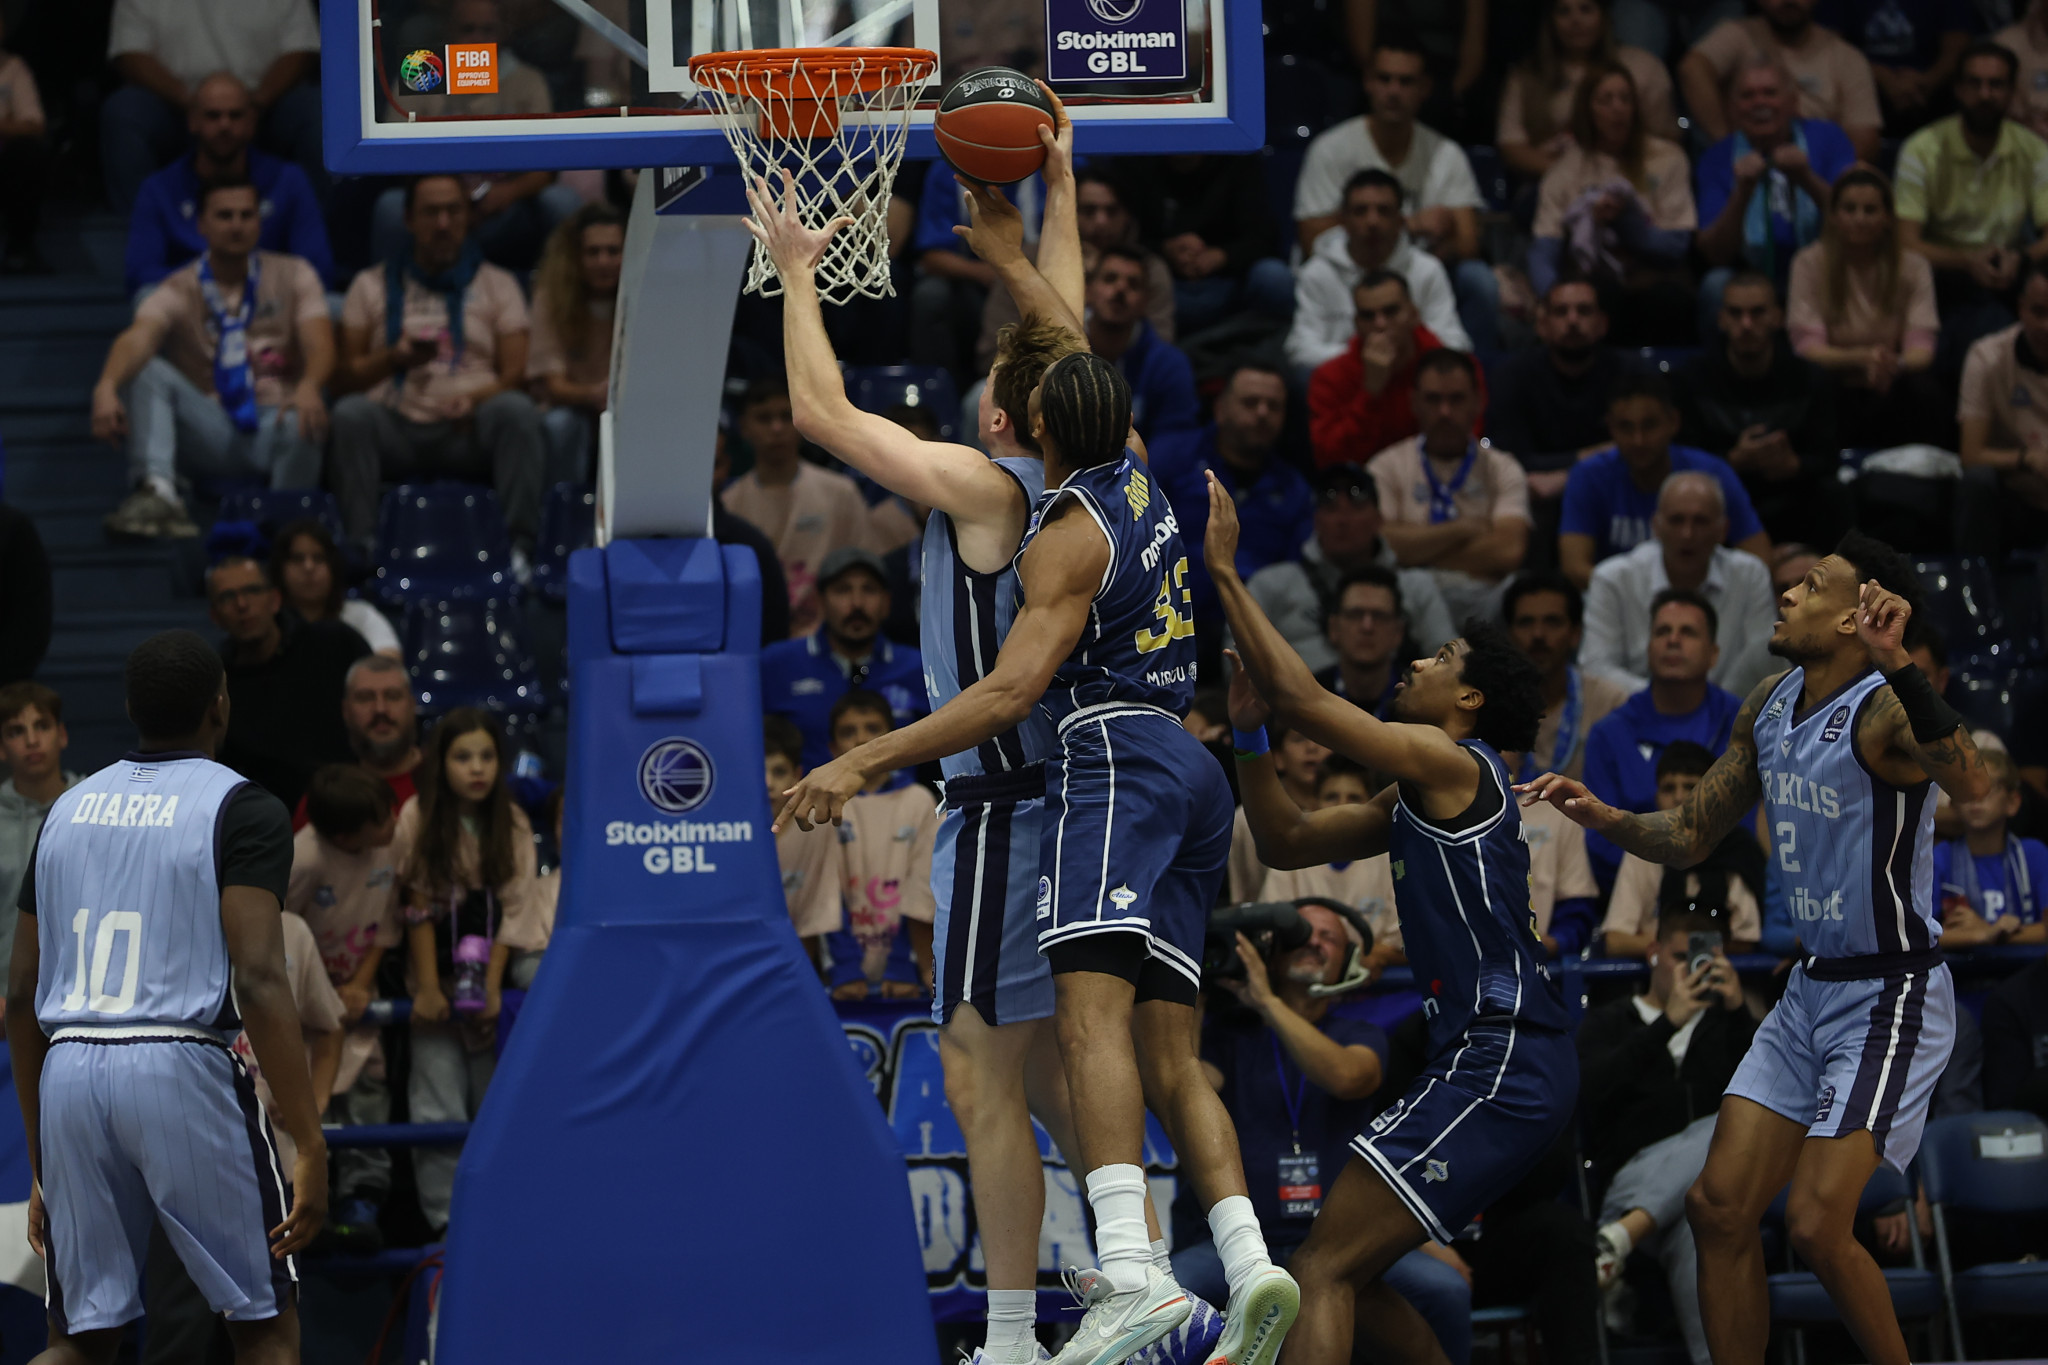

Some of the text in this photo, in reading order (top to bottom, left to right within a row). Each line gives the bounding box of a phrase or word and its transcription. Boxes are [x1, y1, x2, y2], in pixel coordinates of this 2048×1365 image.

[1057, 31, 1176, 50] Stoiximan
[456, 50, 490, 67] FIBA
[1087, 51, 1147, 74] GBL
[456, 79, 491, 87] EQUIPMENT
[1761, 769, 1841, 818] RKLIS
[70, 792, 180, 828] DIARRA
[605, 820, 753, 846] Stoiximan
[1776, 821, 1801, 873] 2
[642, 845, 717, 875] GBL
[60, 908, 142, 1015] 10
